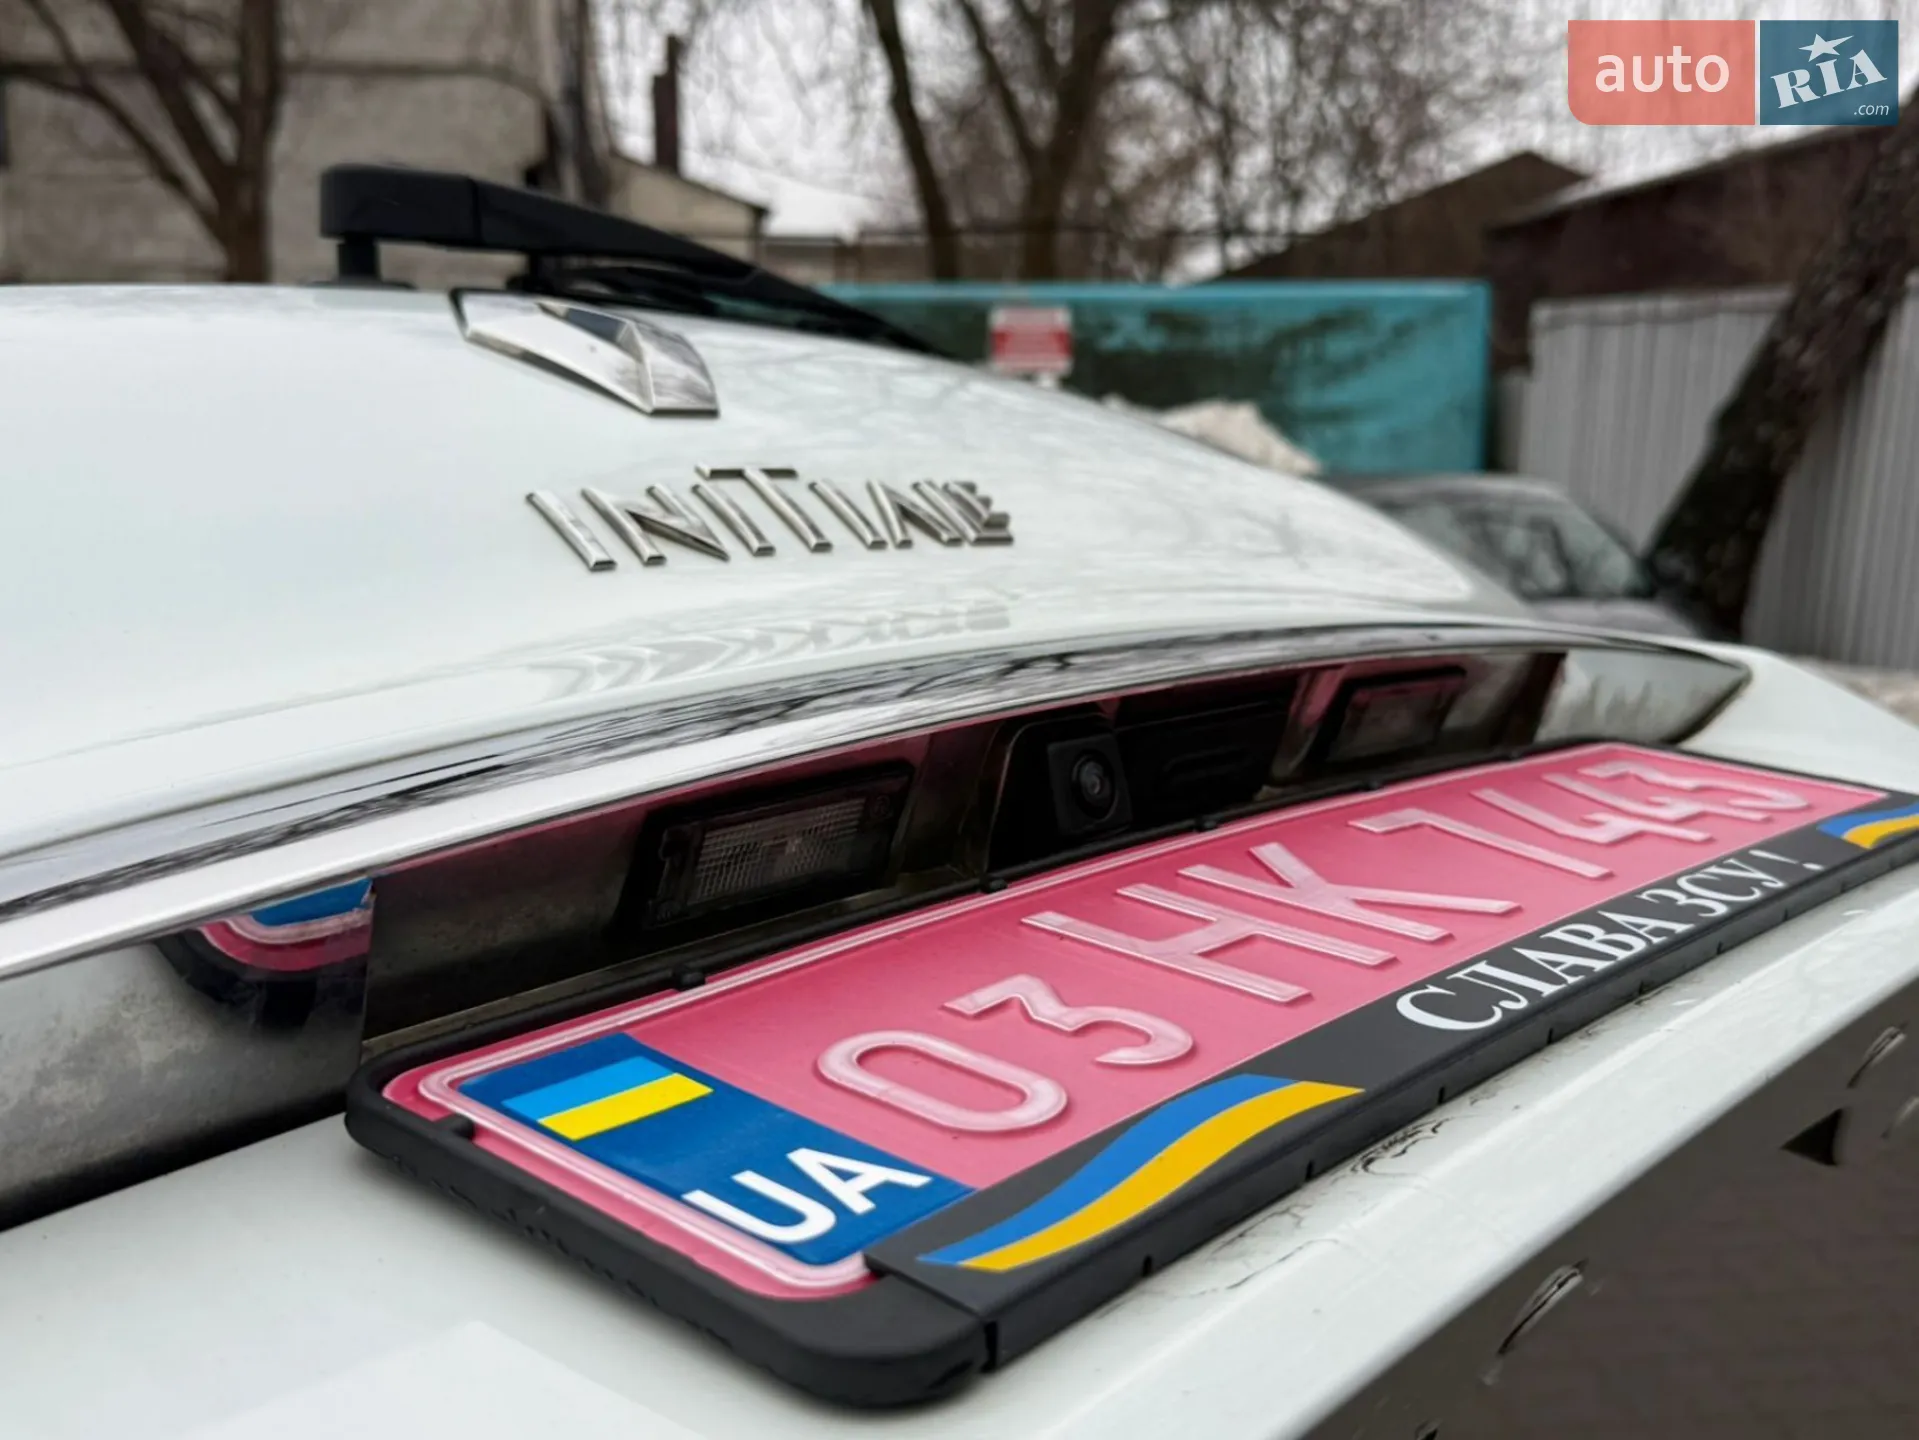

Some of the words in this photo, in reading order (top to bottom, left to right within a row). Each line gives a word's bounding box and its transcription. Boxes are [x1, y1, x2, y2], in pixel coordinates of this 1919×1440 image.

[816, 974, 1195, 1132] 03
[1020, 842, 1523, 1003] HK
[1396, 910, 1696, 1031] СЛАВА
[681, 1147, 932, 1243] UA
